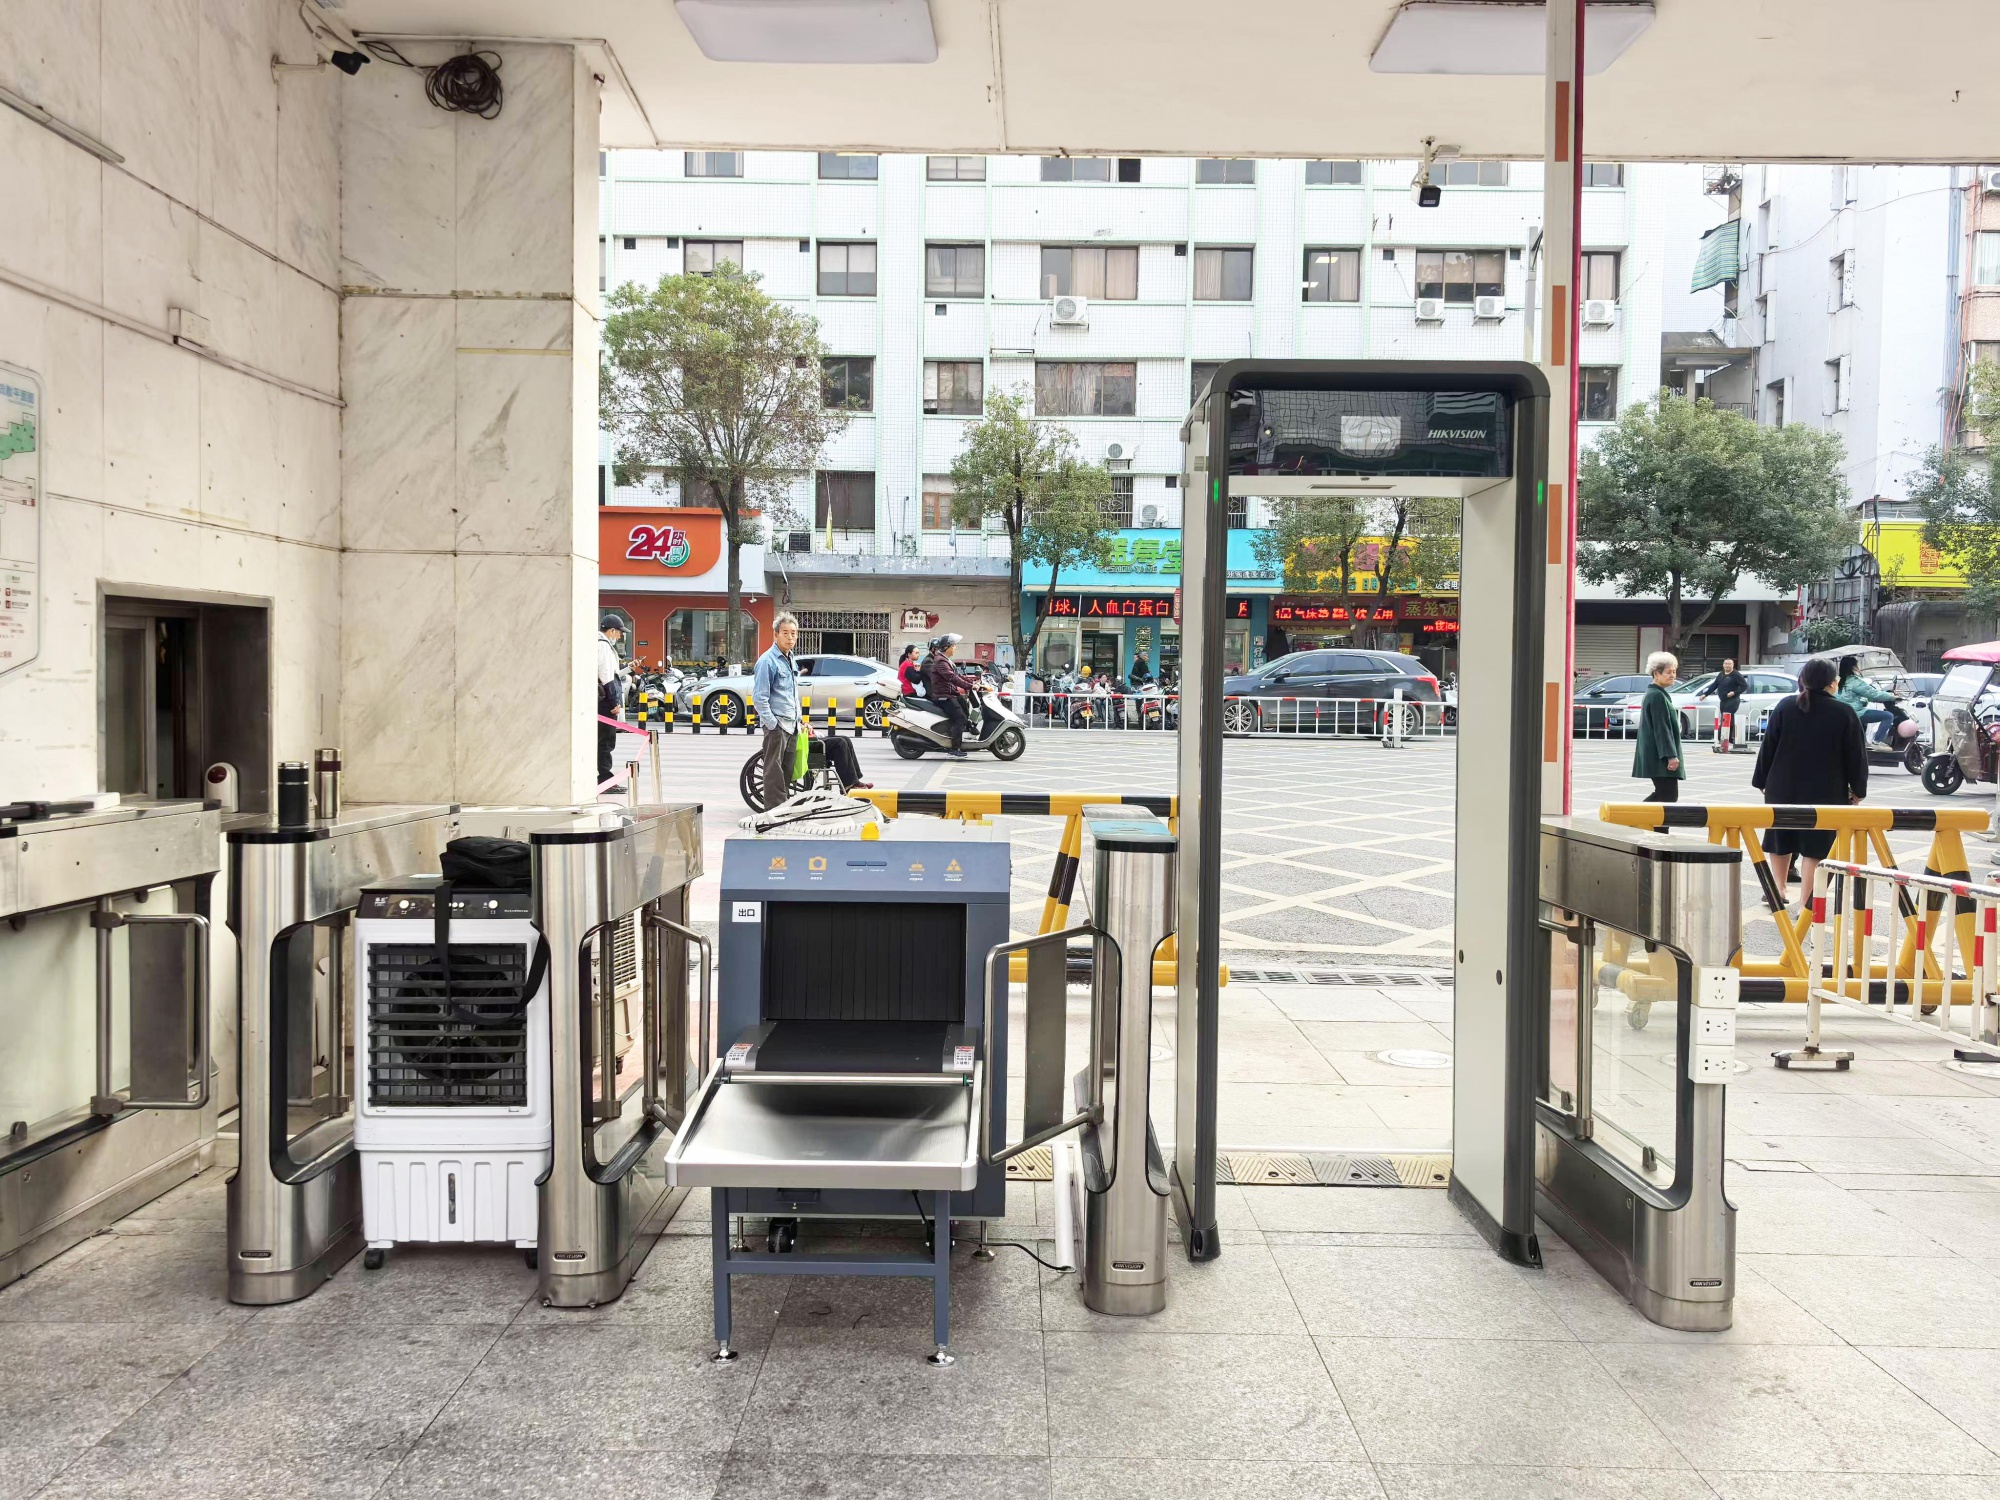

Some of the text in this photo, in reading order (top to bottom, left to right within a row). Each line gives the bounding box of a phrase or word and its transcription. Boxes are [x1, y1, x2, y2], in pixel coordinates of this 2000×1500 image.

[1427, 429, 1488, 439] HIKVISION
[626, 525, 673, 560] 24
[1405, 601, 1457, 617] 蒸笼饭
[738, 908, 755, 917] 出口
